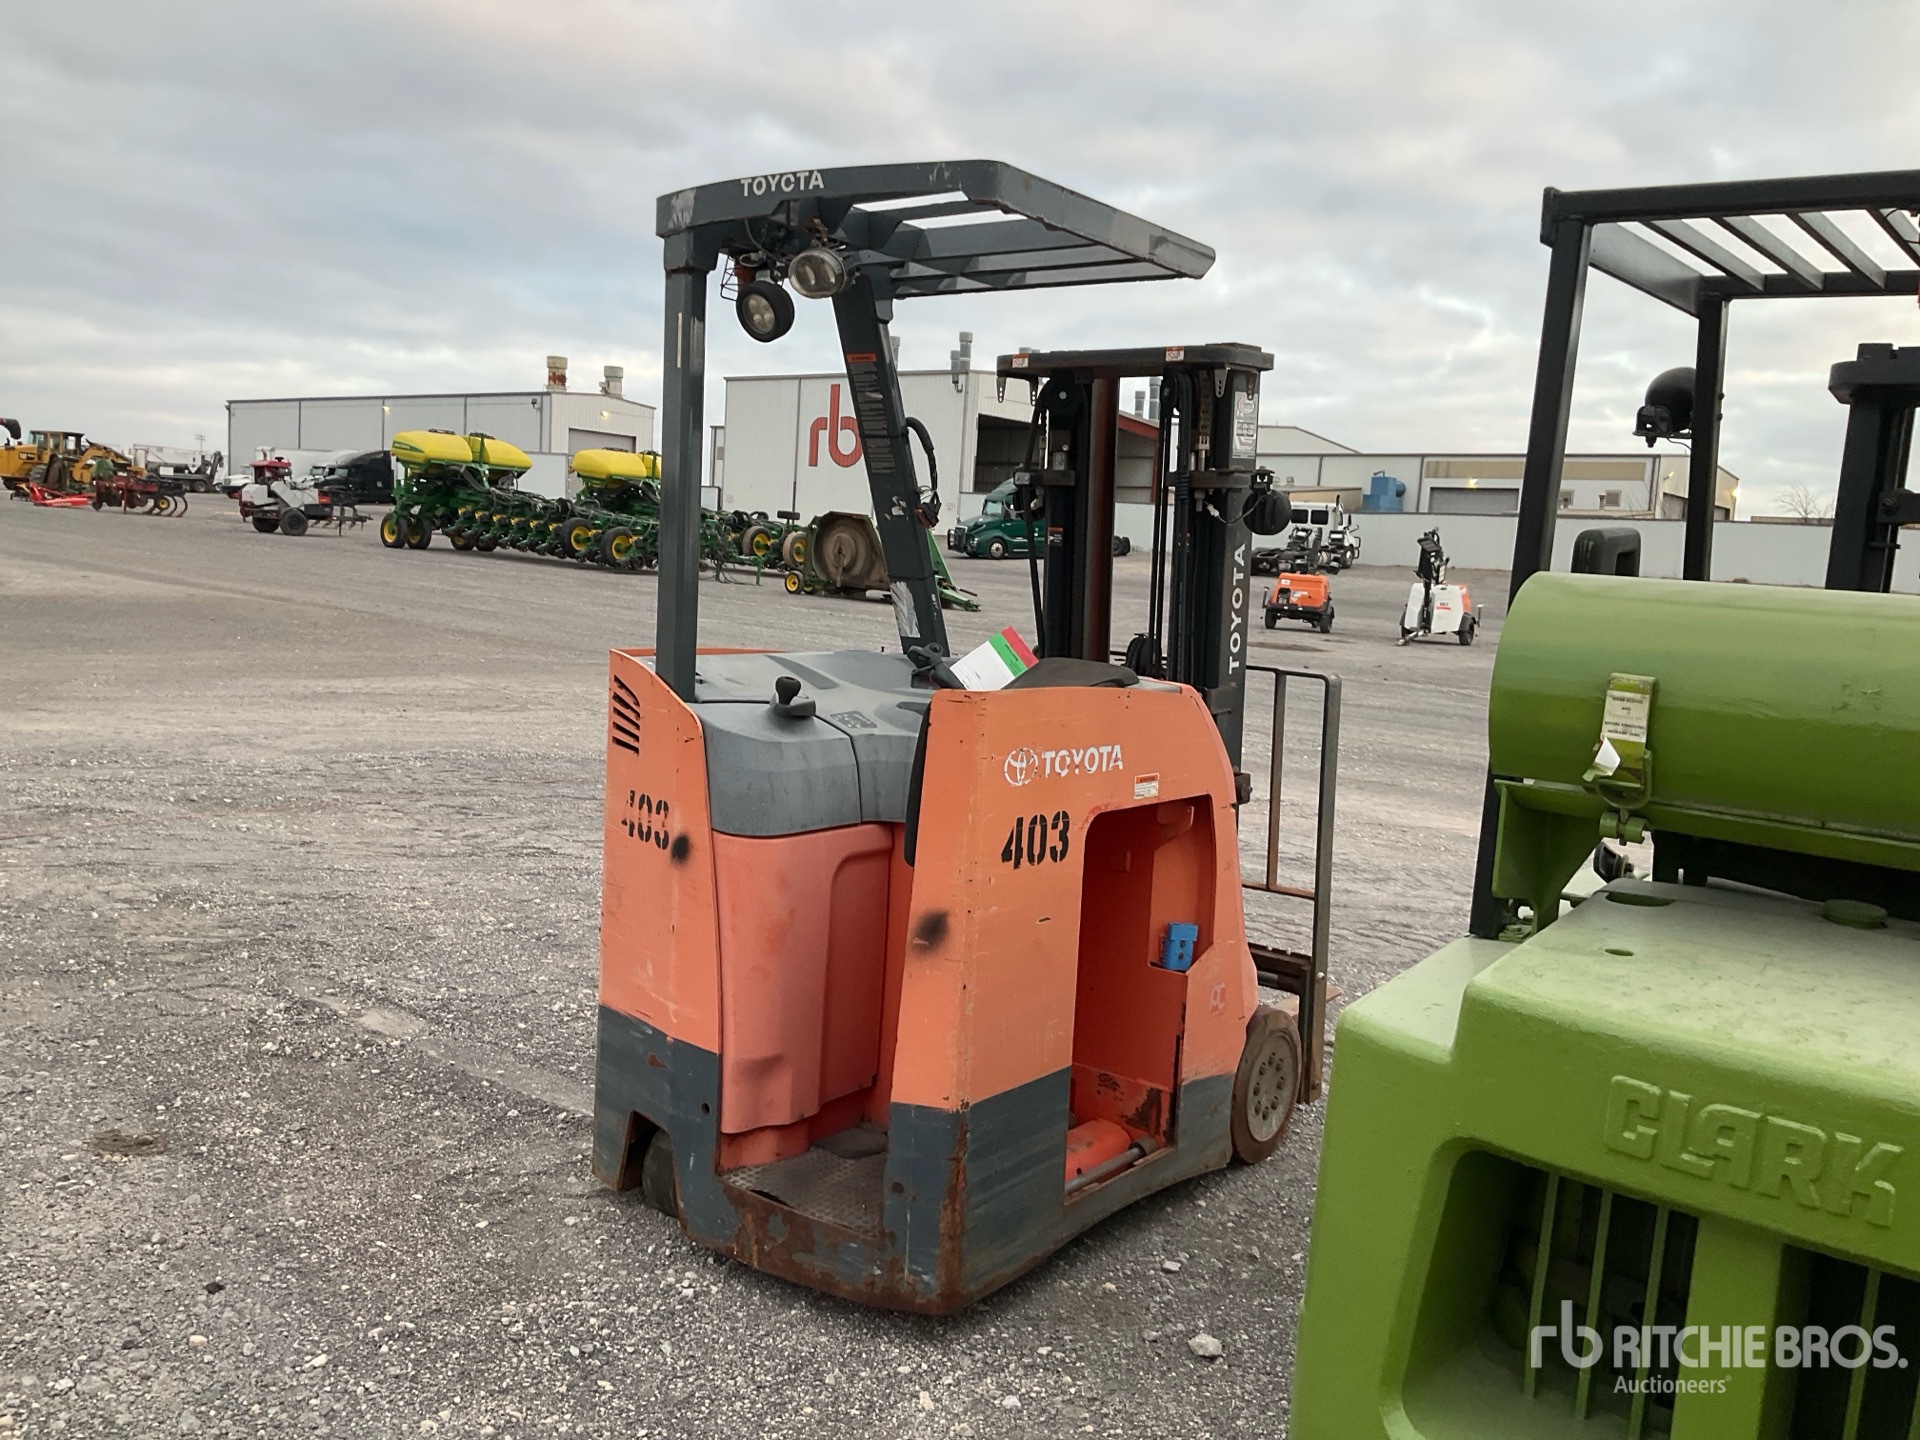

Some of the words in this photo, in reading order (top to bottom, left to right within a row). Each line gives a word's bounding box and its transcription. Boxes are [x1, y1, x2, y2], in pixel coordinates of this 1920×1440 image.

[740, 170, 825, 197] TOYOTA
[808, 383, 863, 468] rb
[1228, 543, 1246, 675] TOYOTA
[1041, 744, 1124, 778] TOYOTA
[620, 789, 670, 850] 403
[1001, 810, 1070, 870] 403
[1604, 1075, 1904, 1230] CLARK
